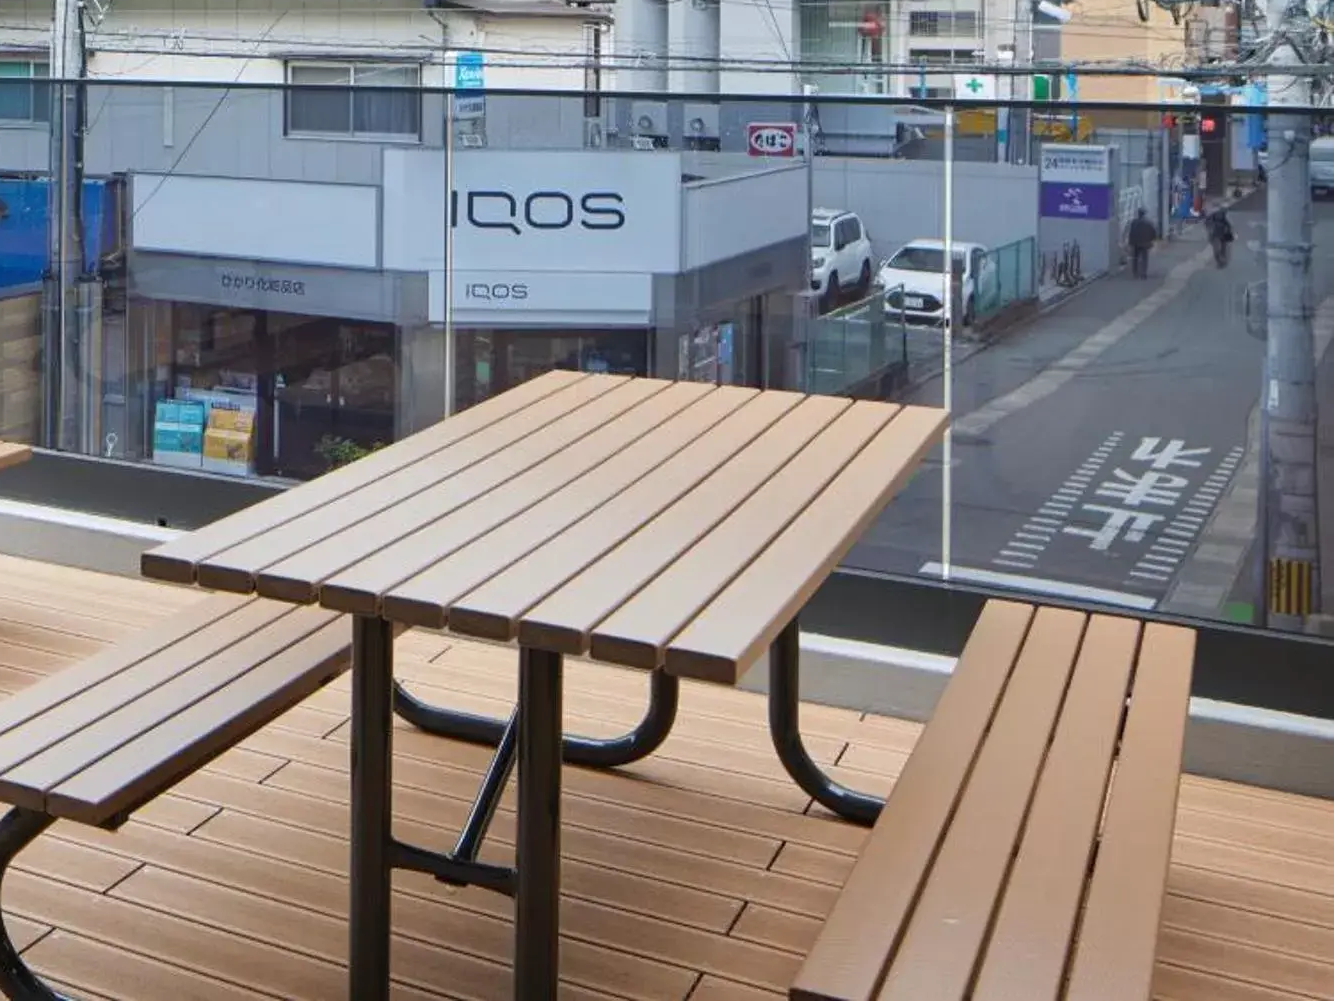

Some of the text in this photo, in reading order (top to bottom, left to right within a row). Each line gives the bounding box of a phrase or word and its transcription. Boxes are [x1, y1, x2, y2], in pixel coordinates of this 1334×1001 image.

[754, 133, 787, 149] たばこ
[451, 190, 625, 235] IQOS
[465, 283, 528, 300] IQOS
[1062, 436, 1212, 551] 止まれ
